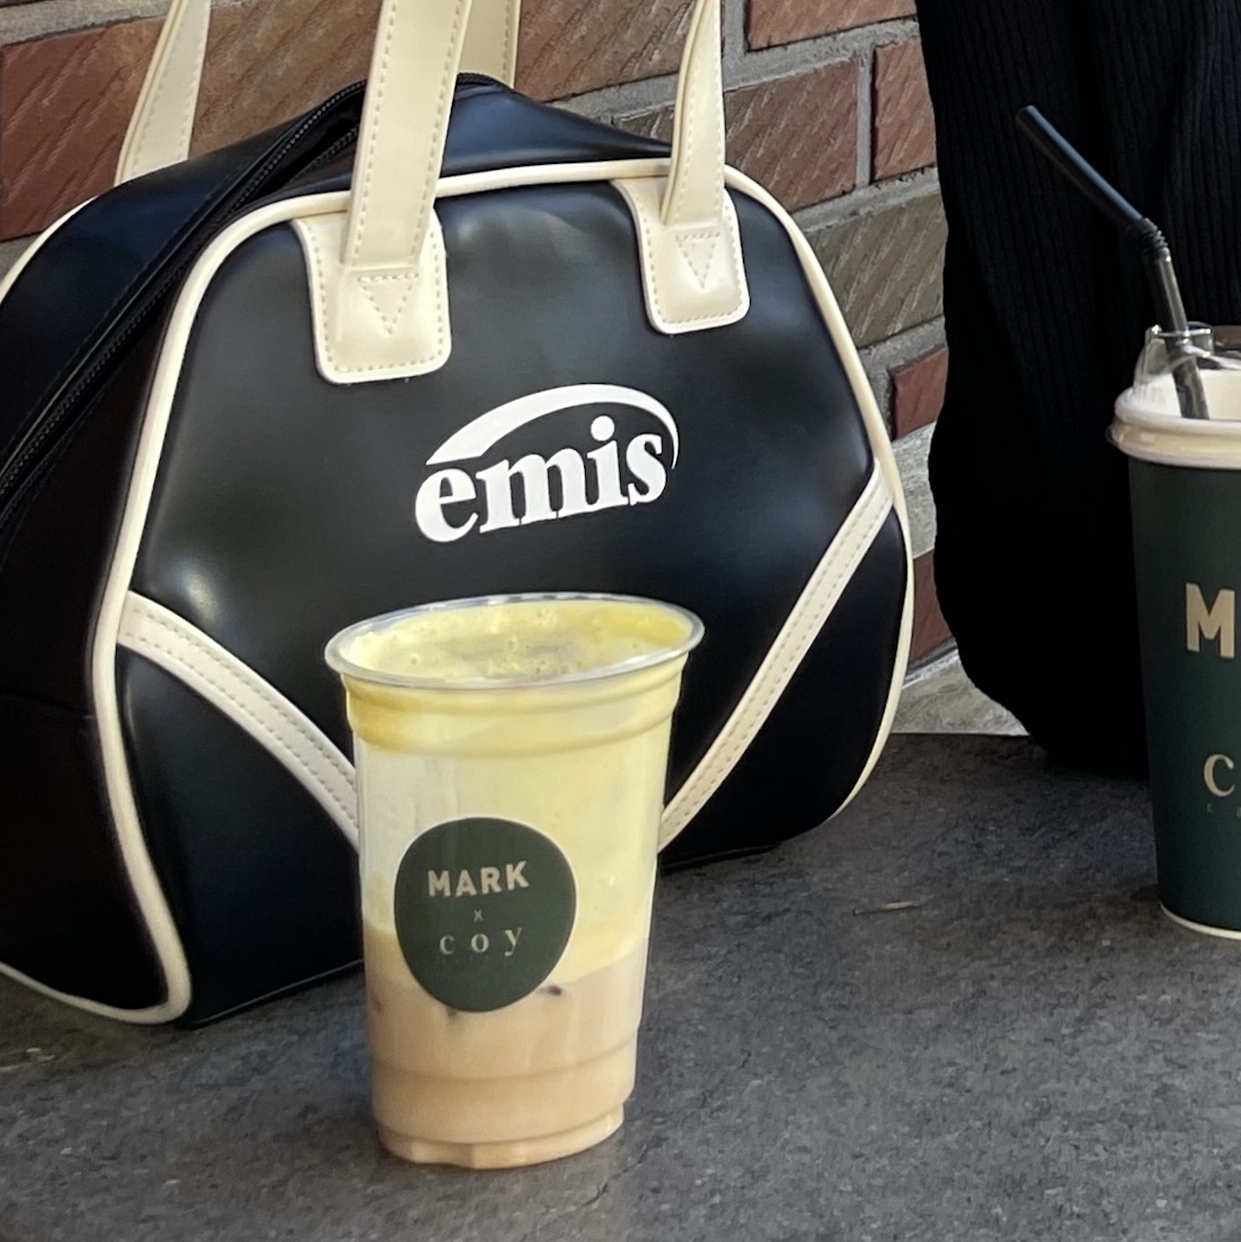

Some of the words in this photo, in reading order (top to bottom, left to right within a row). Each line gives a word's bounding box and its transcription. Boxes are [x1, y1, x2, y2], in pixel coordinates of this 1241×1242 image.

[415, 415, 667, 542] emis
[427, 861, 529, 897] MARK
[439, 927, 522, 957] coy
